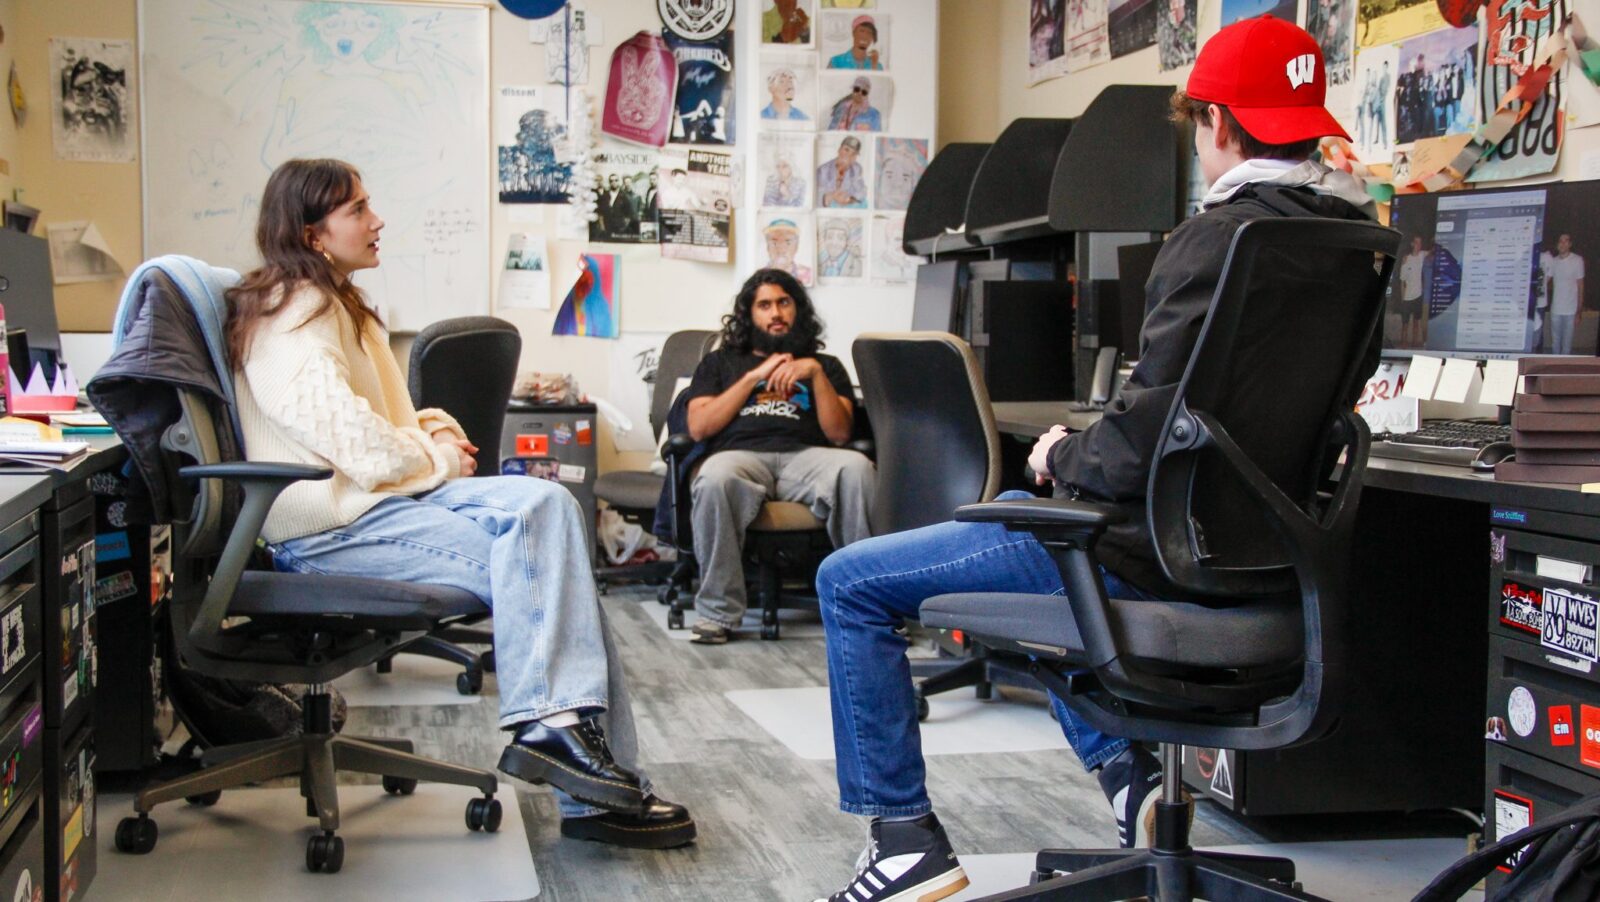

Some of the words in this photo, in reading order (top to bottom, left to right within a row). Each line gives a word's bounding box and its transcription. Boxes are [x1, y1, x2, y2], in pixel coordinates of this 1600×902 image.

[1286, 53, 1316, 90] W
[1568, 598, 1595, 627] WVFS
[1582, 635, 1595, 657] FM
